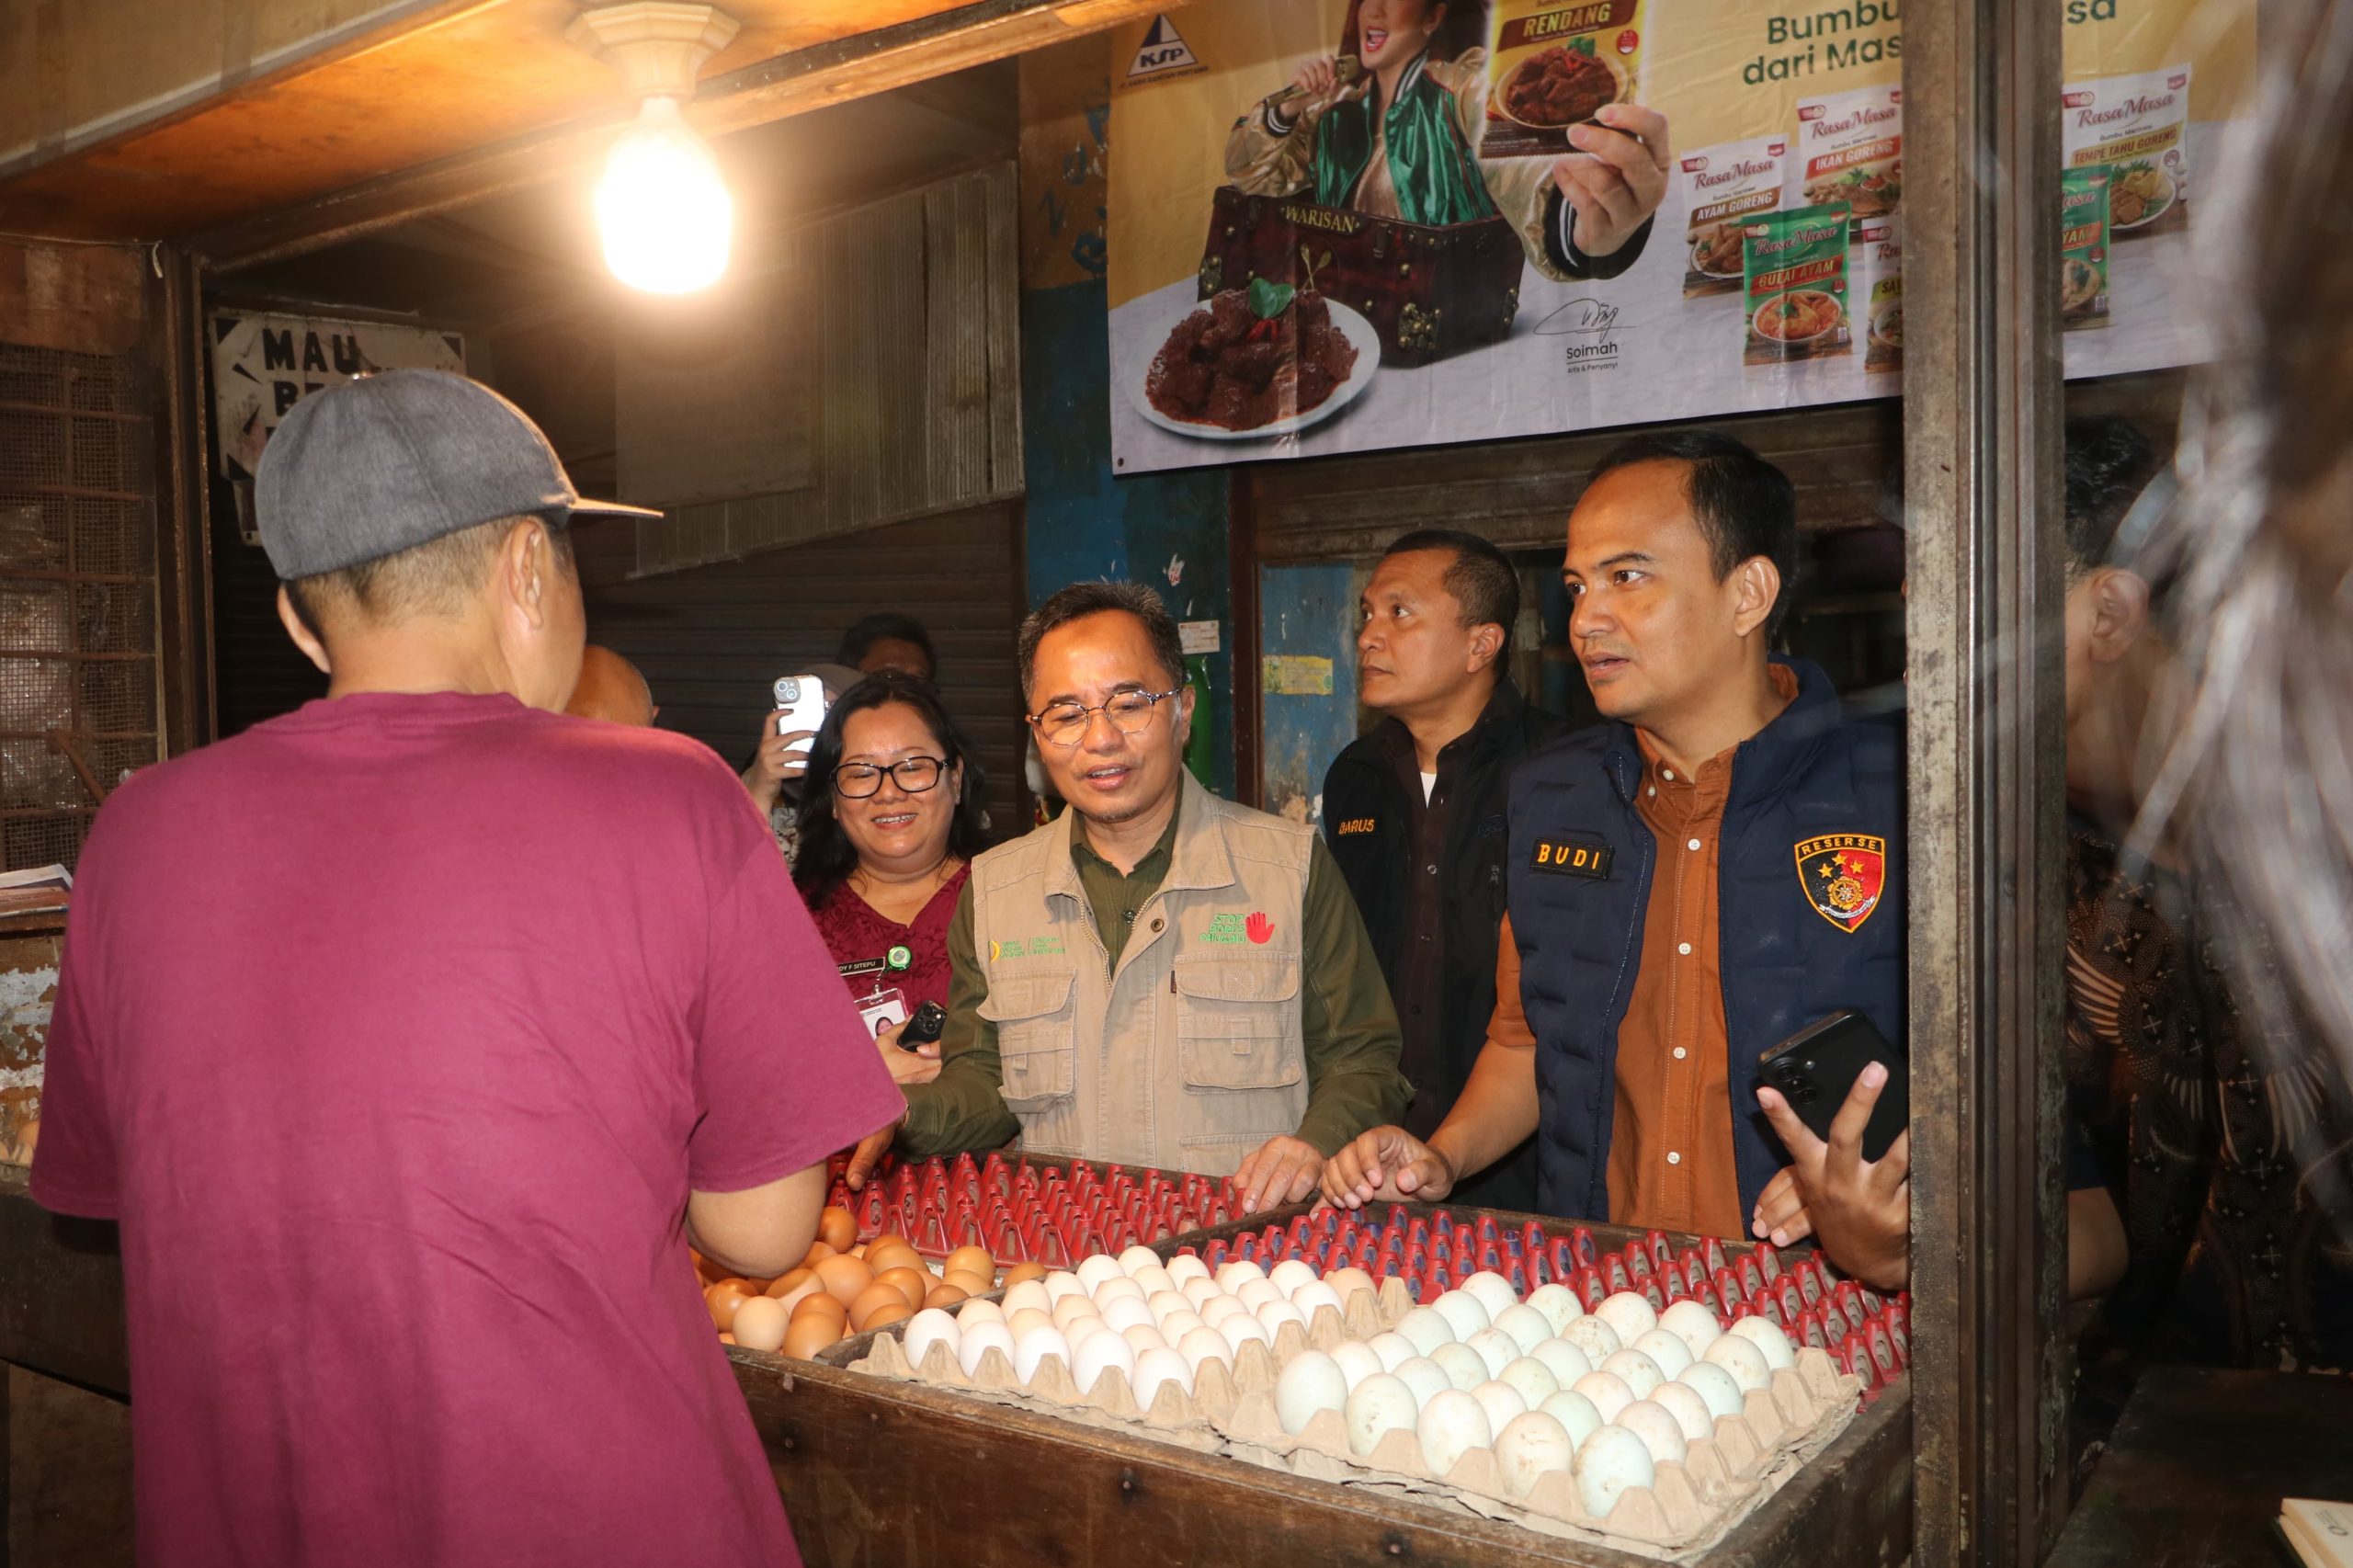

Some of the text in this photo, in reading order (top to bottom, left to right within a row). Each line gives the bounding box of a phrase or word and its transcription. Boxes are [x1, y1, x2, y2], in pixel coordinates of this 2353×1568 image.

[1523, 3, 1611, 38] RENDANG
[1767, 0, 1902, 45] Bumbu
[1140, 48, 1184, 68] KSP
[1743, 44, 1814, 85] dari
[1815, 141, 1894, 171] IKAN GORENG
[2074, 148, 2107, 164] TEMPE
[2109, 141, 2135, 155] TAHU
[2137, 128, 2177, 149] GORENG
[1286, 206, 1356, 234] WARISAN
[1697, 192, 1773, 222] AYAM GORENG
[1758, 260, 1834, 288] GULAI AYAM
[262, 328, 362, 375] MAU
[1566, 341, 1618, 359] Soimah
[1537, 843, 1600, 870] BUDI
[1801, 836, 1878, 856] RESERSE
[1213, 914, 1245, 924] STOP
[853, 960, 876, 970] SITEPU
